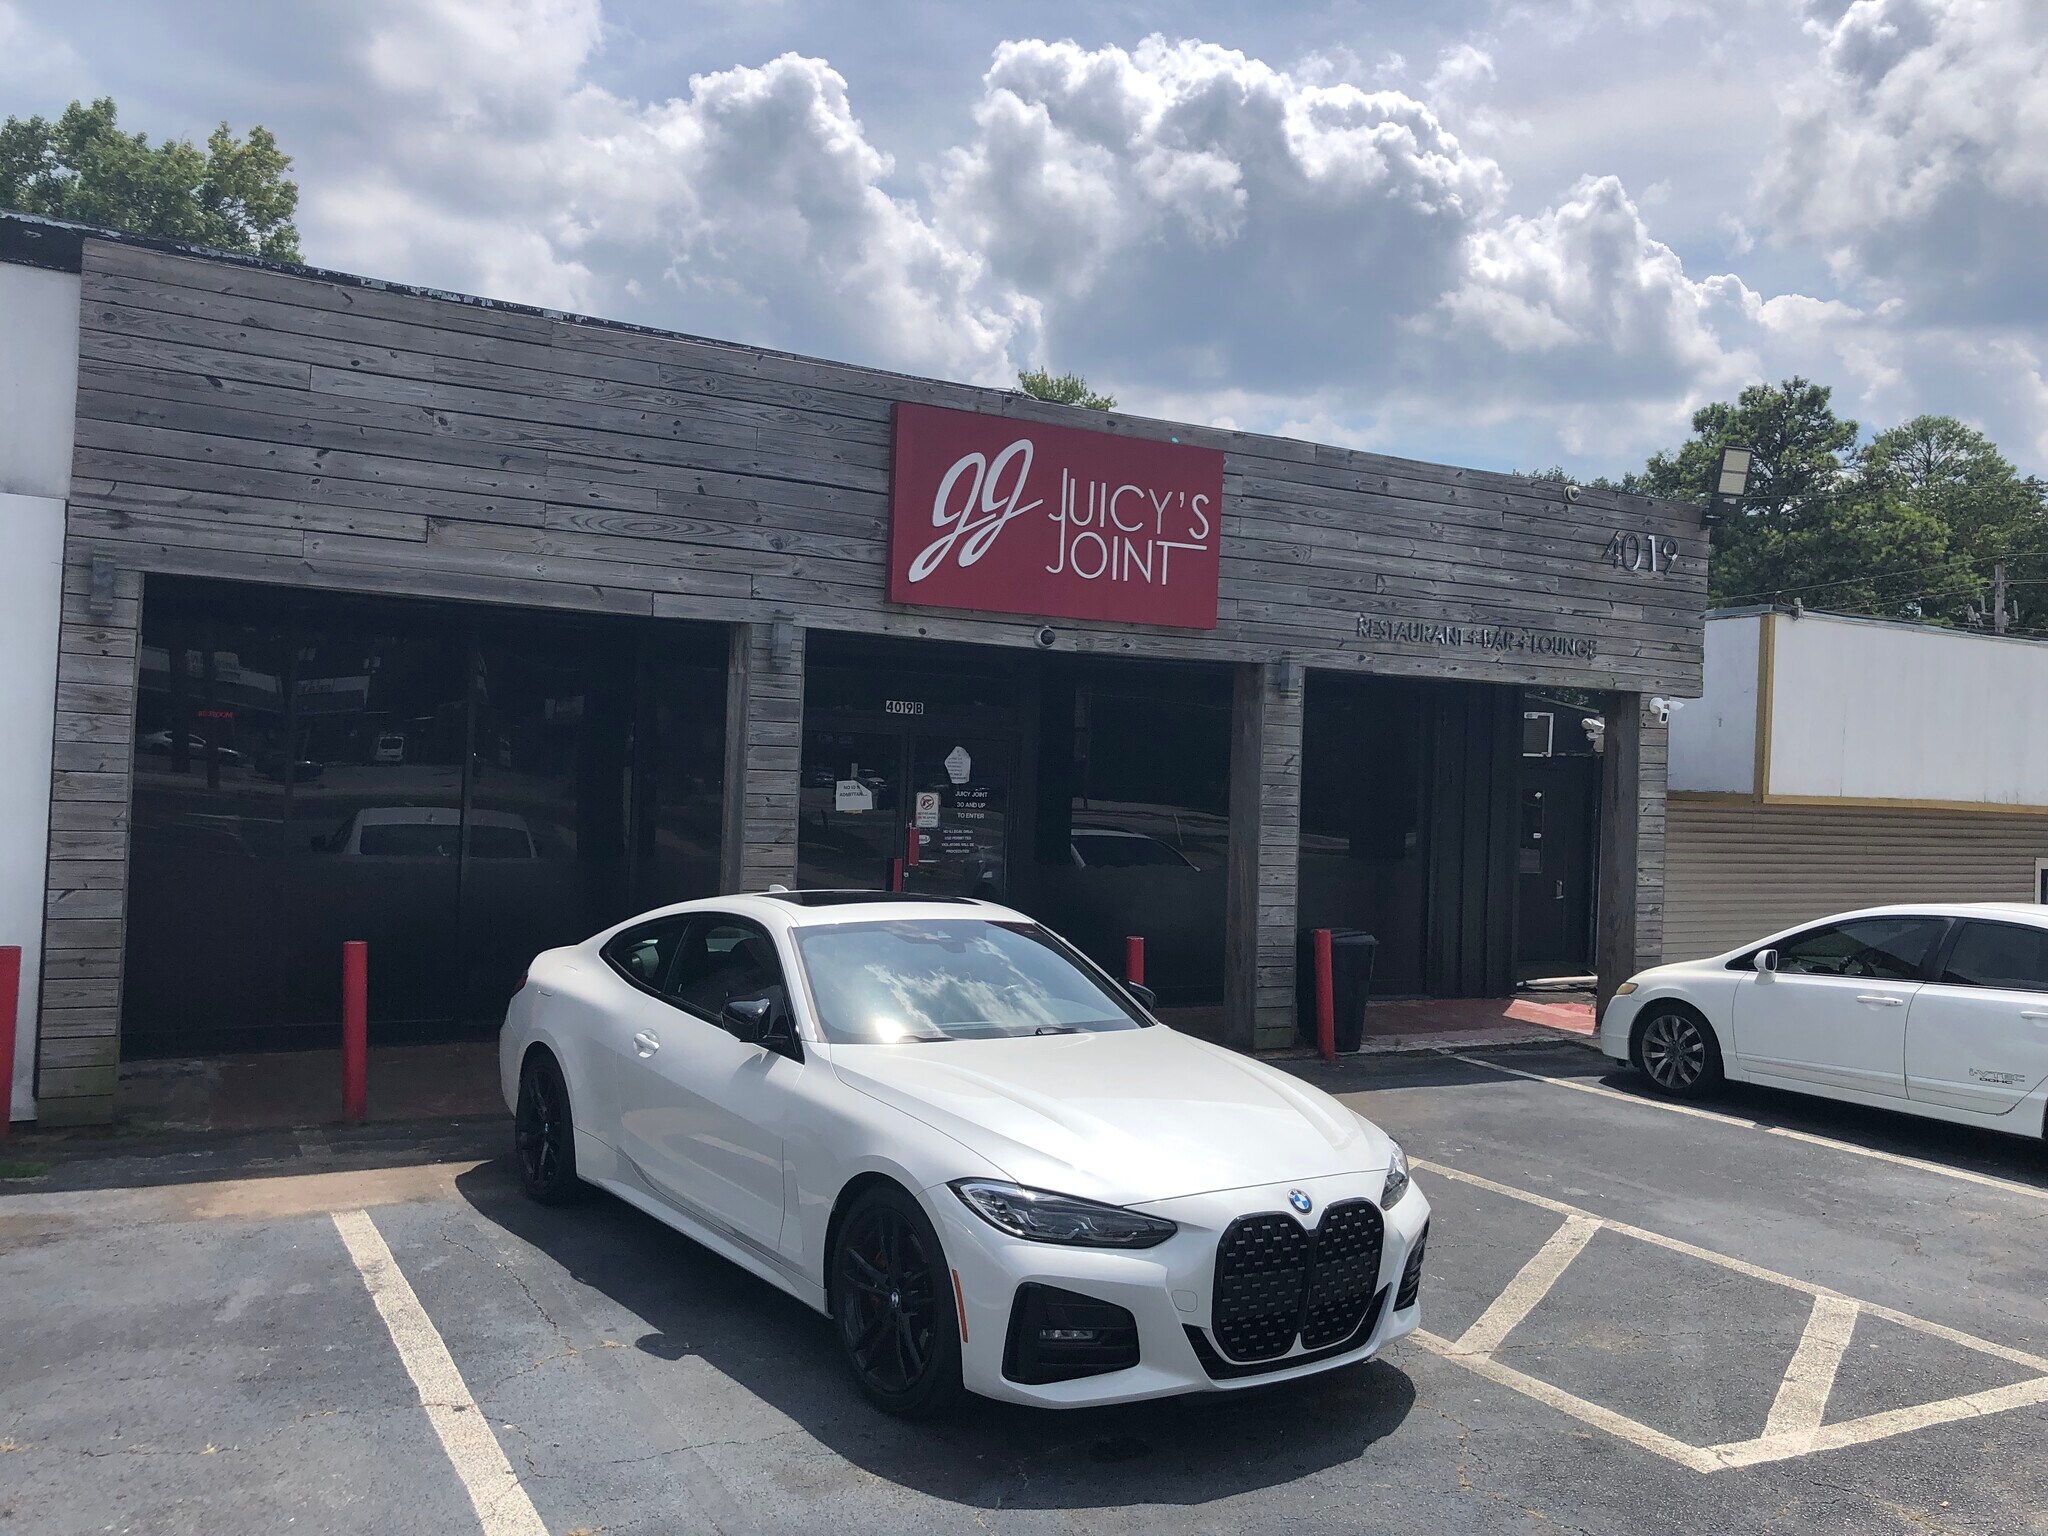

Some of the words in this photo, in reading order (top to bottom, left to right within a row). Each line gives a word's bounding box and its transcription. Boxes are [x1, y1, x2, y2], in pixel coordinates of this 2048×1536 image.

[1048, 467, 1210, 540] JUICY'S
[1045, 529, 1207, 585] JOINT
[1601, 530, 1680, 575] 4019
[1357, 616, 1465, 646] RESTAURANT
[1482, 629, 1515, 652] BAR
[1530, 634, 1598, 660] LOUNGE
[1979, 1077, 2014, 1085] DOHC
